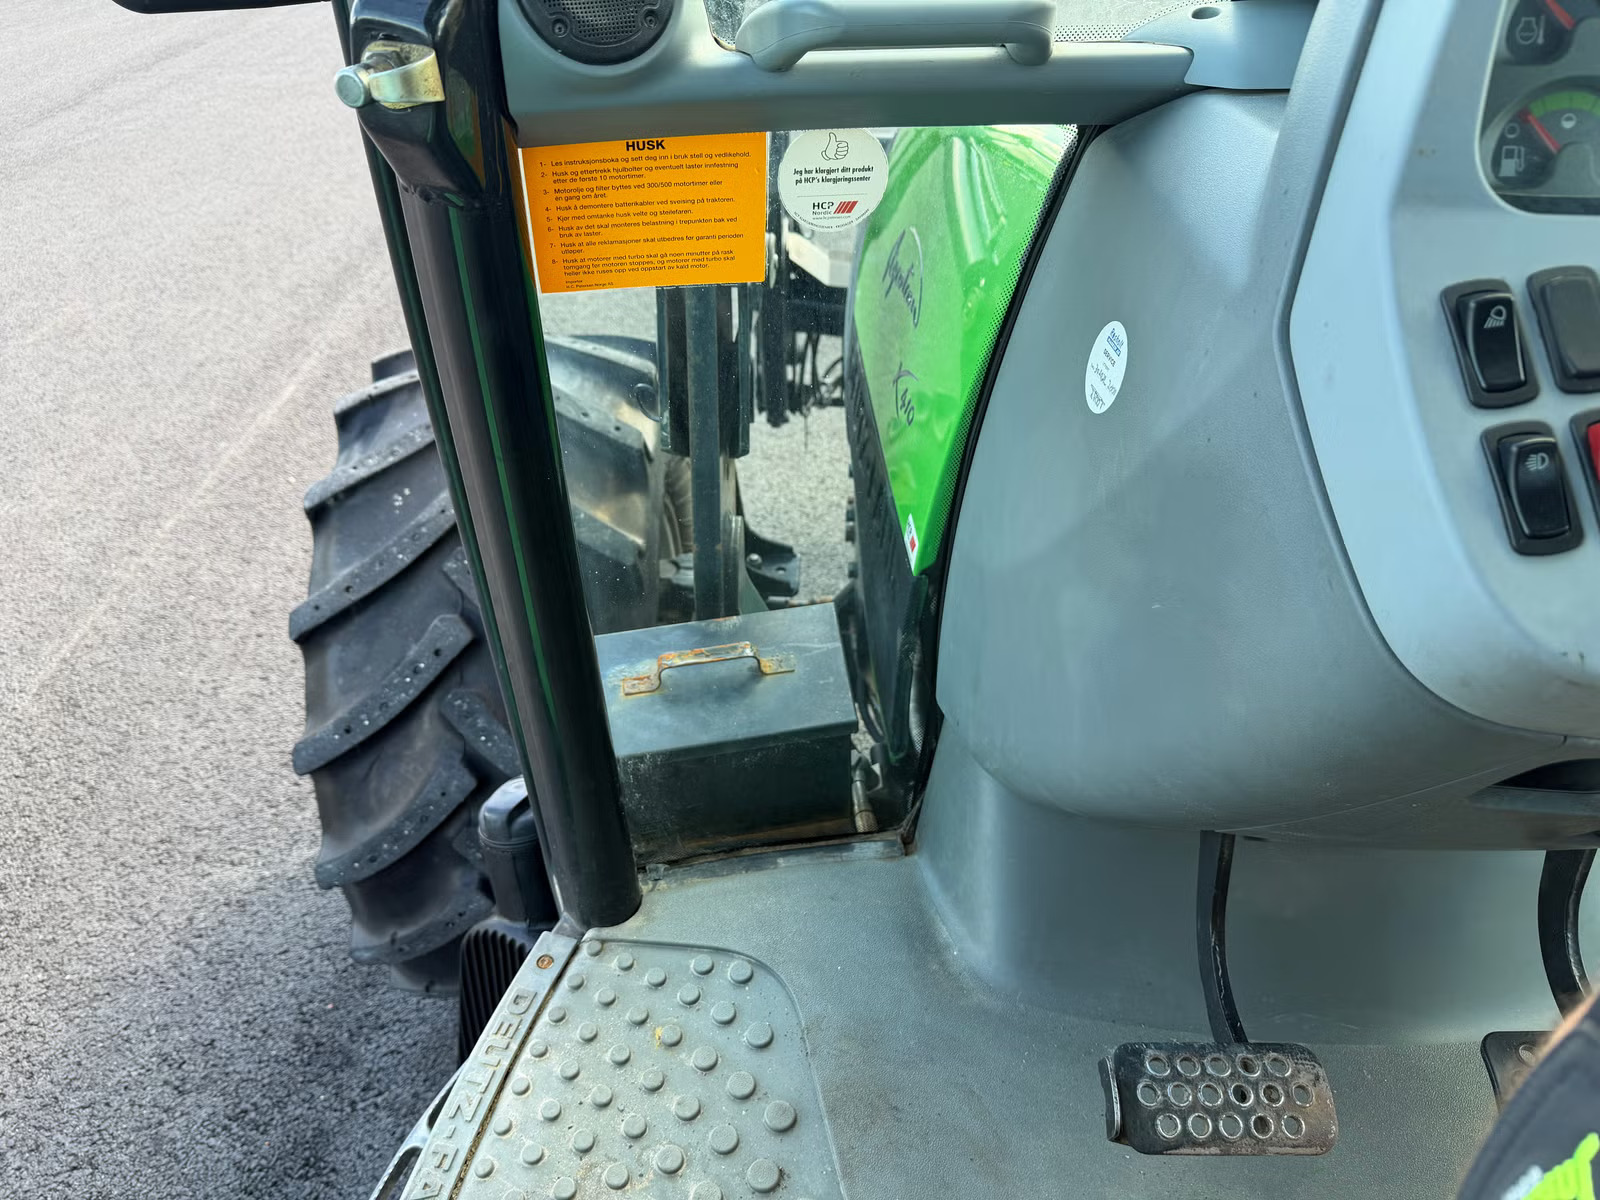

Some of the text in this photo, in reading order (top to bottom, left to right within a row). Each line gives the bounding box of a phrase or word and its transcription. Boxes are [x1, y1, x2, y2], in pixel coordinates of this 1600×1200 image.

[626, 139, 665, 151] HUSK
[564, 158, 618, 166] instruksjonsboka
[852, 165, 874, 174] produkt
[795, 177, 802, 186] på
[812, 201, 834, 210] HCP
[598, 238, 641, 246] reklamasjoner
[1103, 348, 1116, 368] SERVICE
